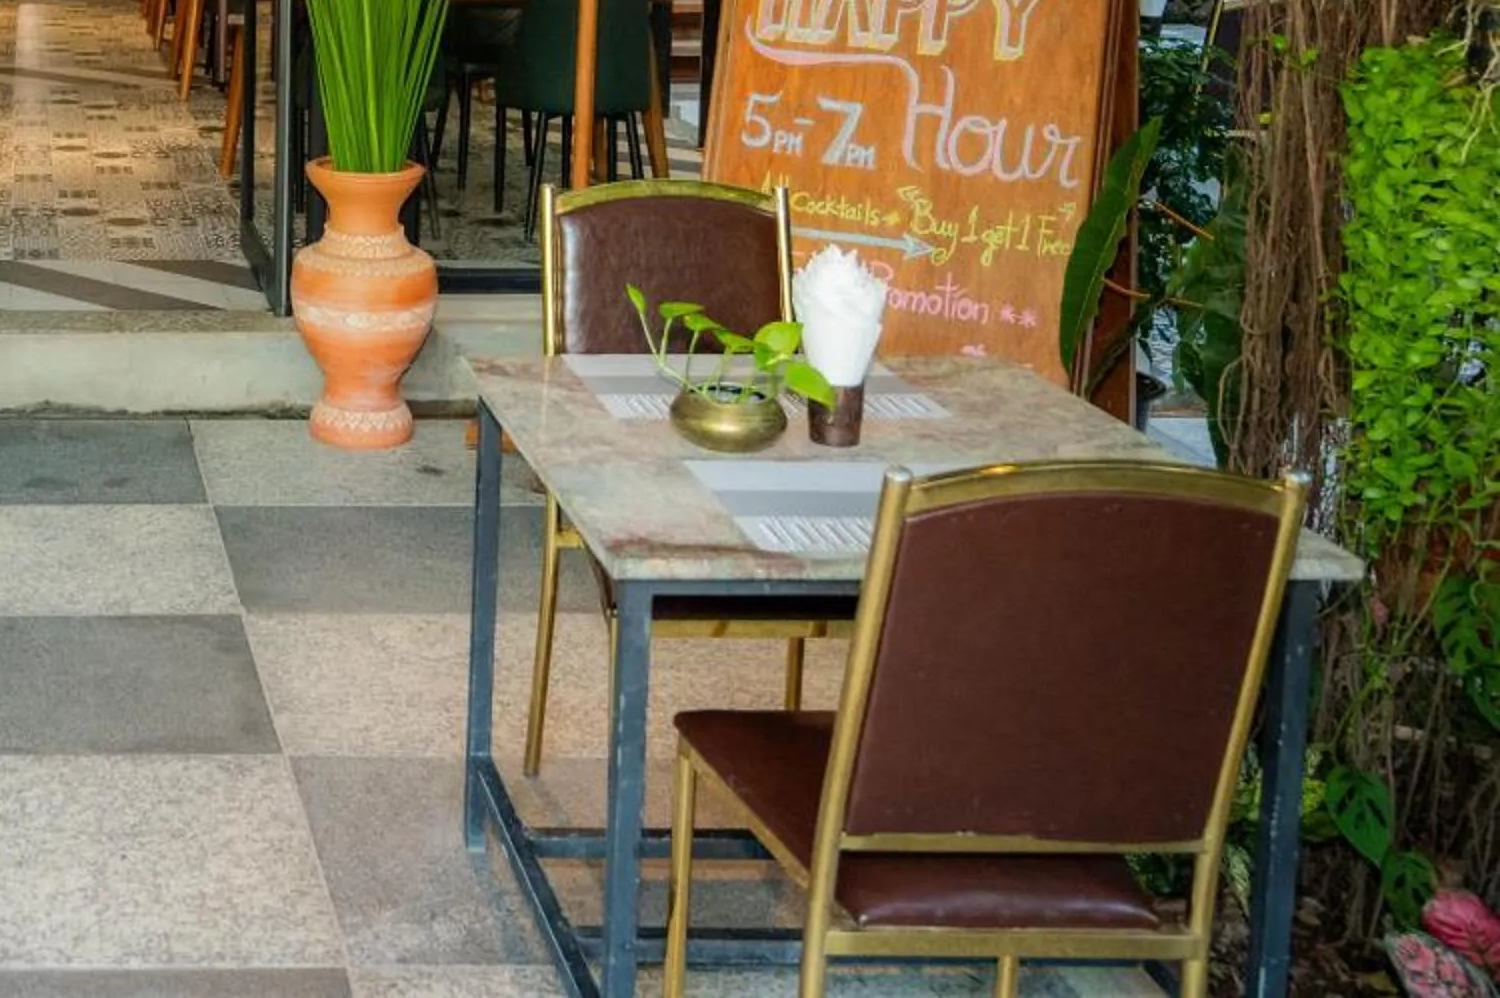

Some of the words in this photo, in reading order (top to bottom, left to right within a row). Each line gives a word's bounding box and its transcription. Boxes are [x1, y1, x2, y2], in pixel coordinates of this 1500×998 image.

[900, 57, 1083, 189] Hour
[960, 205, 980, 244] 1
[980, 209, 1019, 268] get
[1015, 213, 1031, 251] 1
